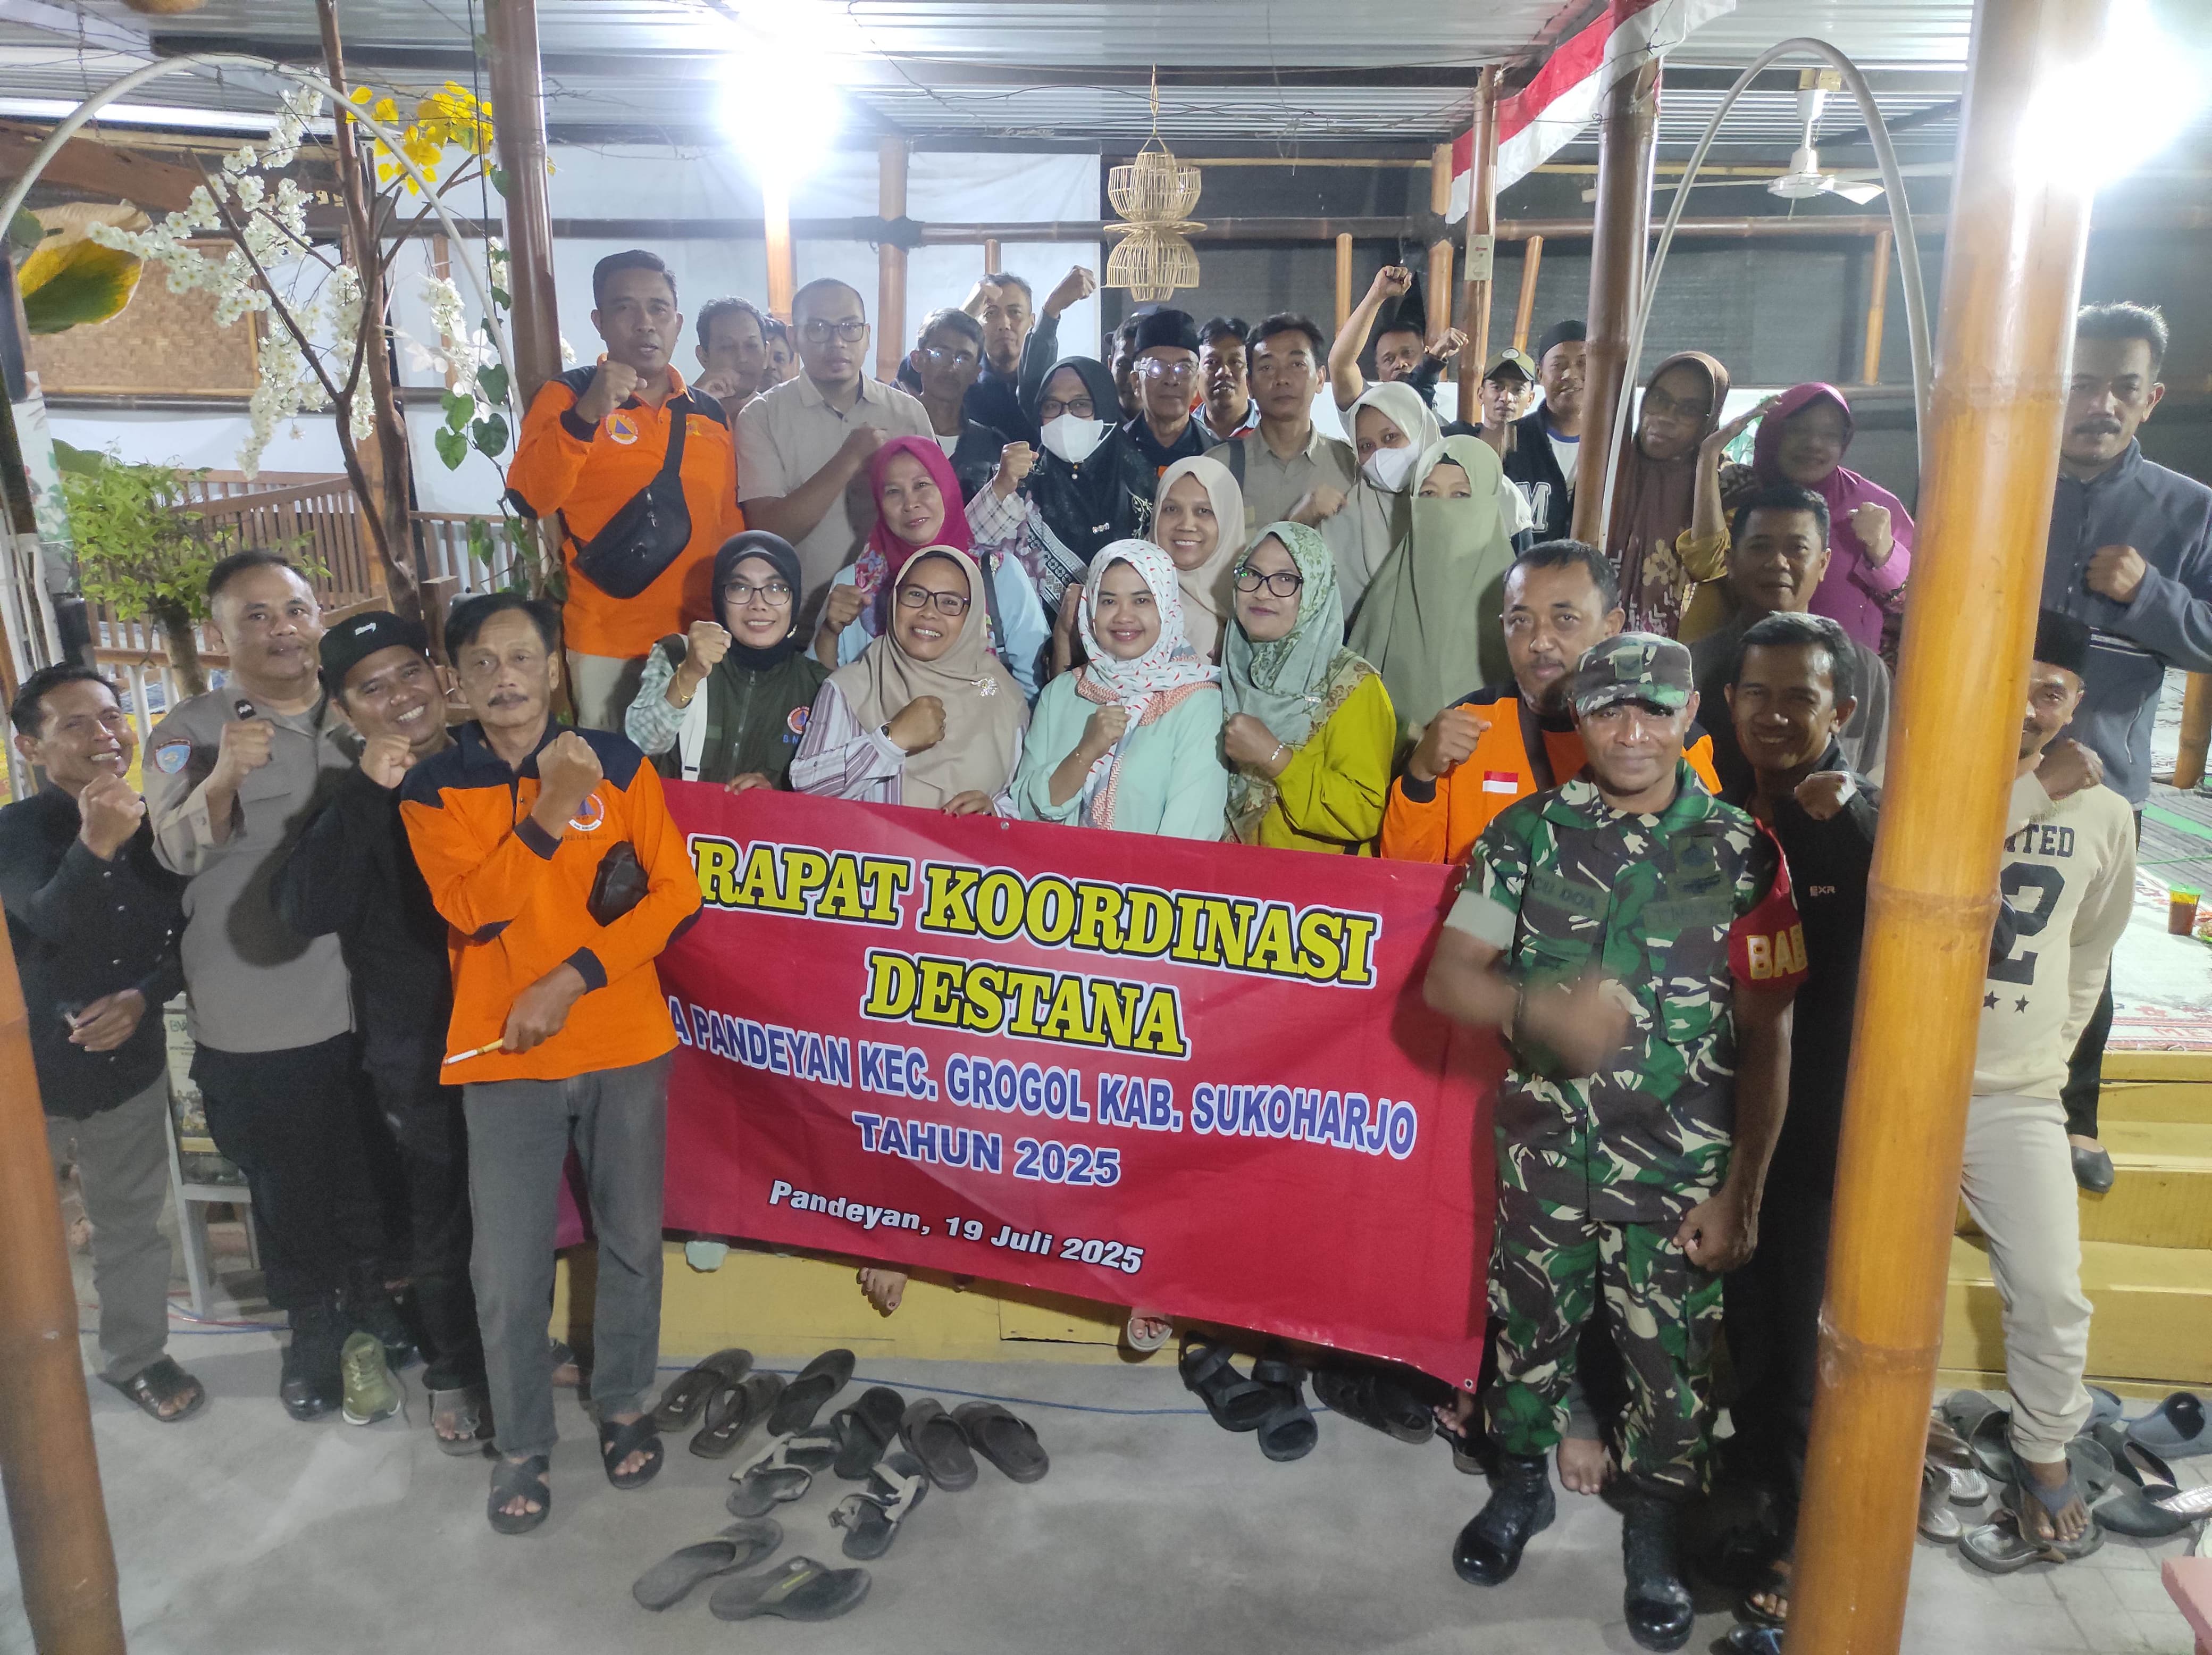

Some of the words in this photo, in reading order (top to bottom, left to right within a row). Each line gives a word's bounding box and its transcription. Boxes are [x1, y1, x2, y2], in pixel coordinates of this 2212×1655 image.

[688, 834, 915, 929] RAPAT
[918, 859, 1382, 989] KOORDINASI
[1987, 862, 2065, 985] 2
[861, 947, 1192, 1061] DESTANA
[690, 1003, 852, 1089] PANDEYAN
[858, 1040, 937, 1102] KEC.
[946, 1055, 1090, 1123] GROGOL
[1097, 1072, 1183, 1133] KAB.
[1191, 1082, 1419, 1160] SUKOHARJO
[851, 1110, 1002, 1174] TAHUN
[1013, 1136, 1121, 1188] 2025
[768, 1179, 932, 1237] Pandeyan,
[944, 1215, 985, 1242] 19
[990, 1224, 1054, 1256] Juli
[1060, 1236, 1146, 1275] 2025
